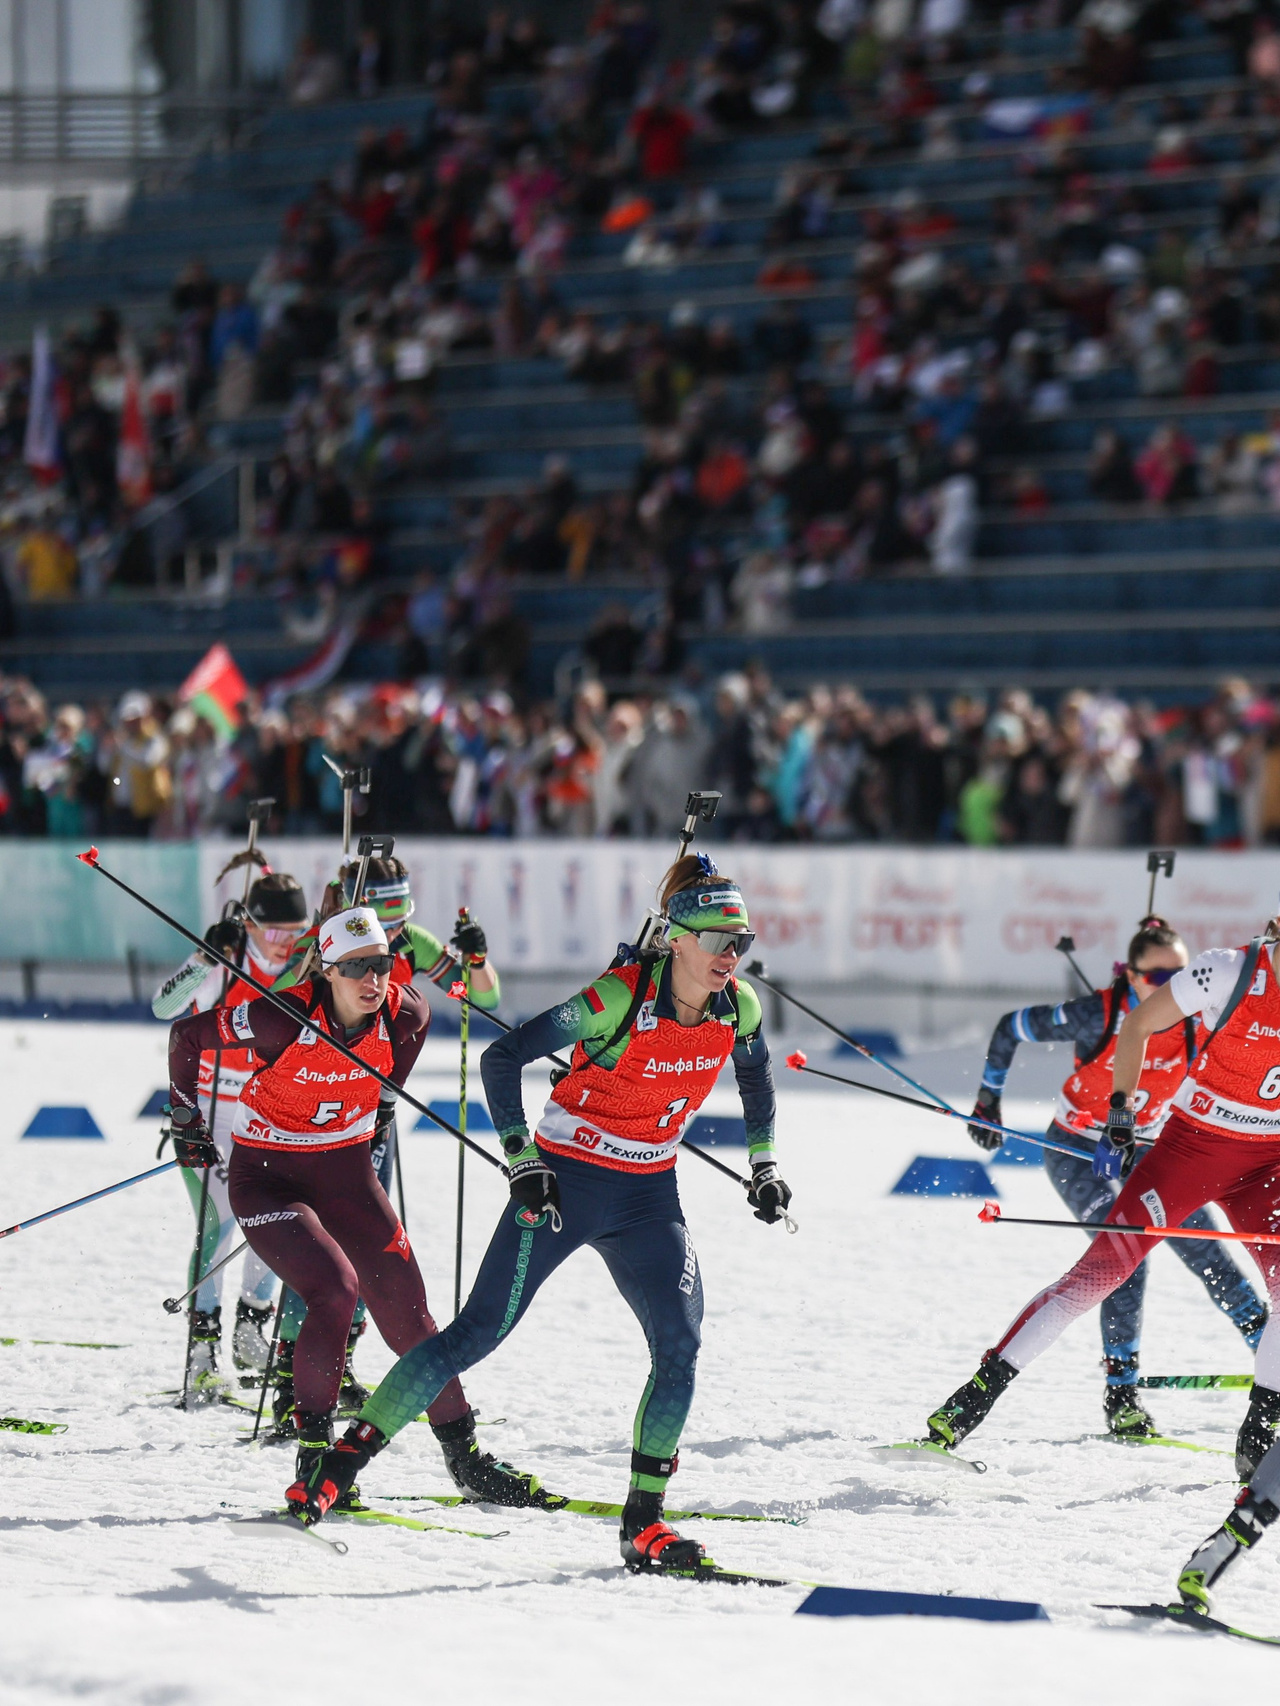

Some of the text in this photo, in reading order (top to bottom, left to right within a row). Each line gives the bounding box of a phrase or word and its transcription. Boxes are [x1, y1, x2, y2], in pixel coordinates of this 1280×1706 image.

[294, 1066, 346, 1084] Альфа
[643, 1057, 694, 1077] Альфа
[578, 1089, 591, 1107] 1
[310, 1100, 344, 1127] 5
[657, 1096, 690, 1128] 1
